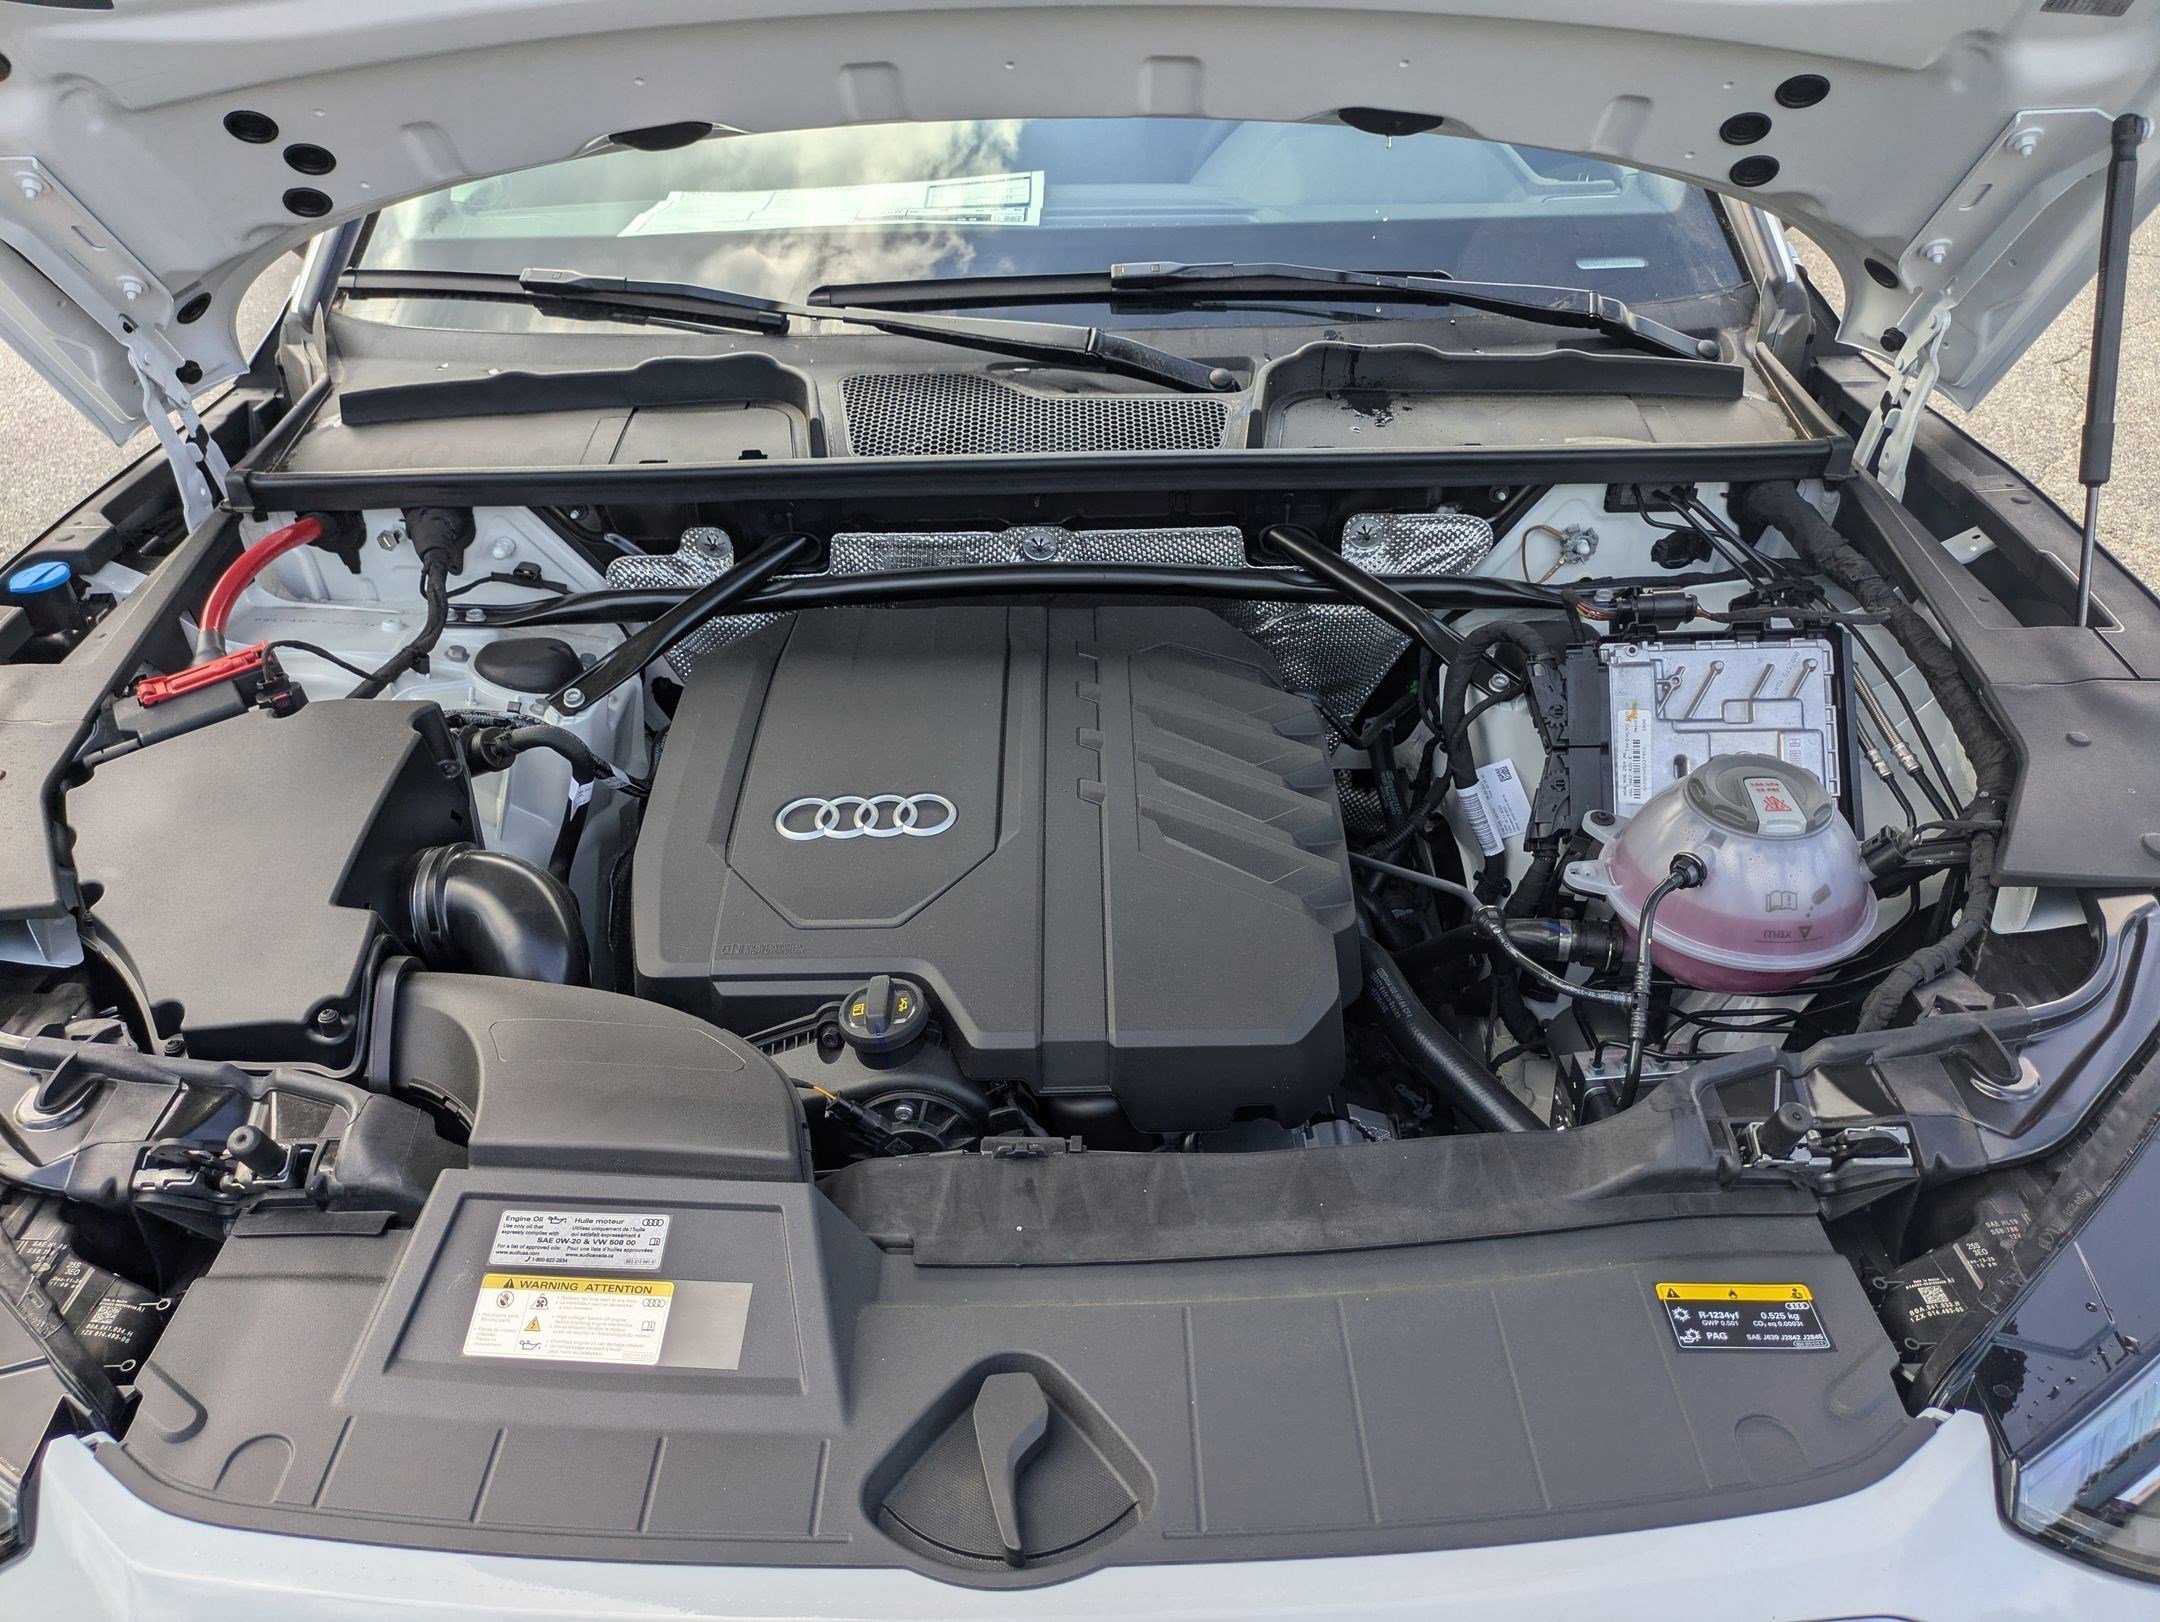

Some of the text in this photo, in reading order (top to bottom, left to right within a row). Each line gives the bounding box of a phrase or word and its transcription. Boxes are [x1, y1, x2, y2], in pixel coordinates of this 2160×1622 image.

[1763, 929, 1792, 939] max
[555, 1237, 582, 1245] 0W-20
[520, 1280, 653, 1294] WARNING ATTENTION
[1698, 1311, 1740, 1320] R-1234yf
[1760, 1311, 1800, 1321] 0.525 kg
[1910, 1313, 1926, 1323] 1ZX
[1706, 1332, 1728, 1340] PAG
